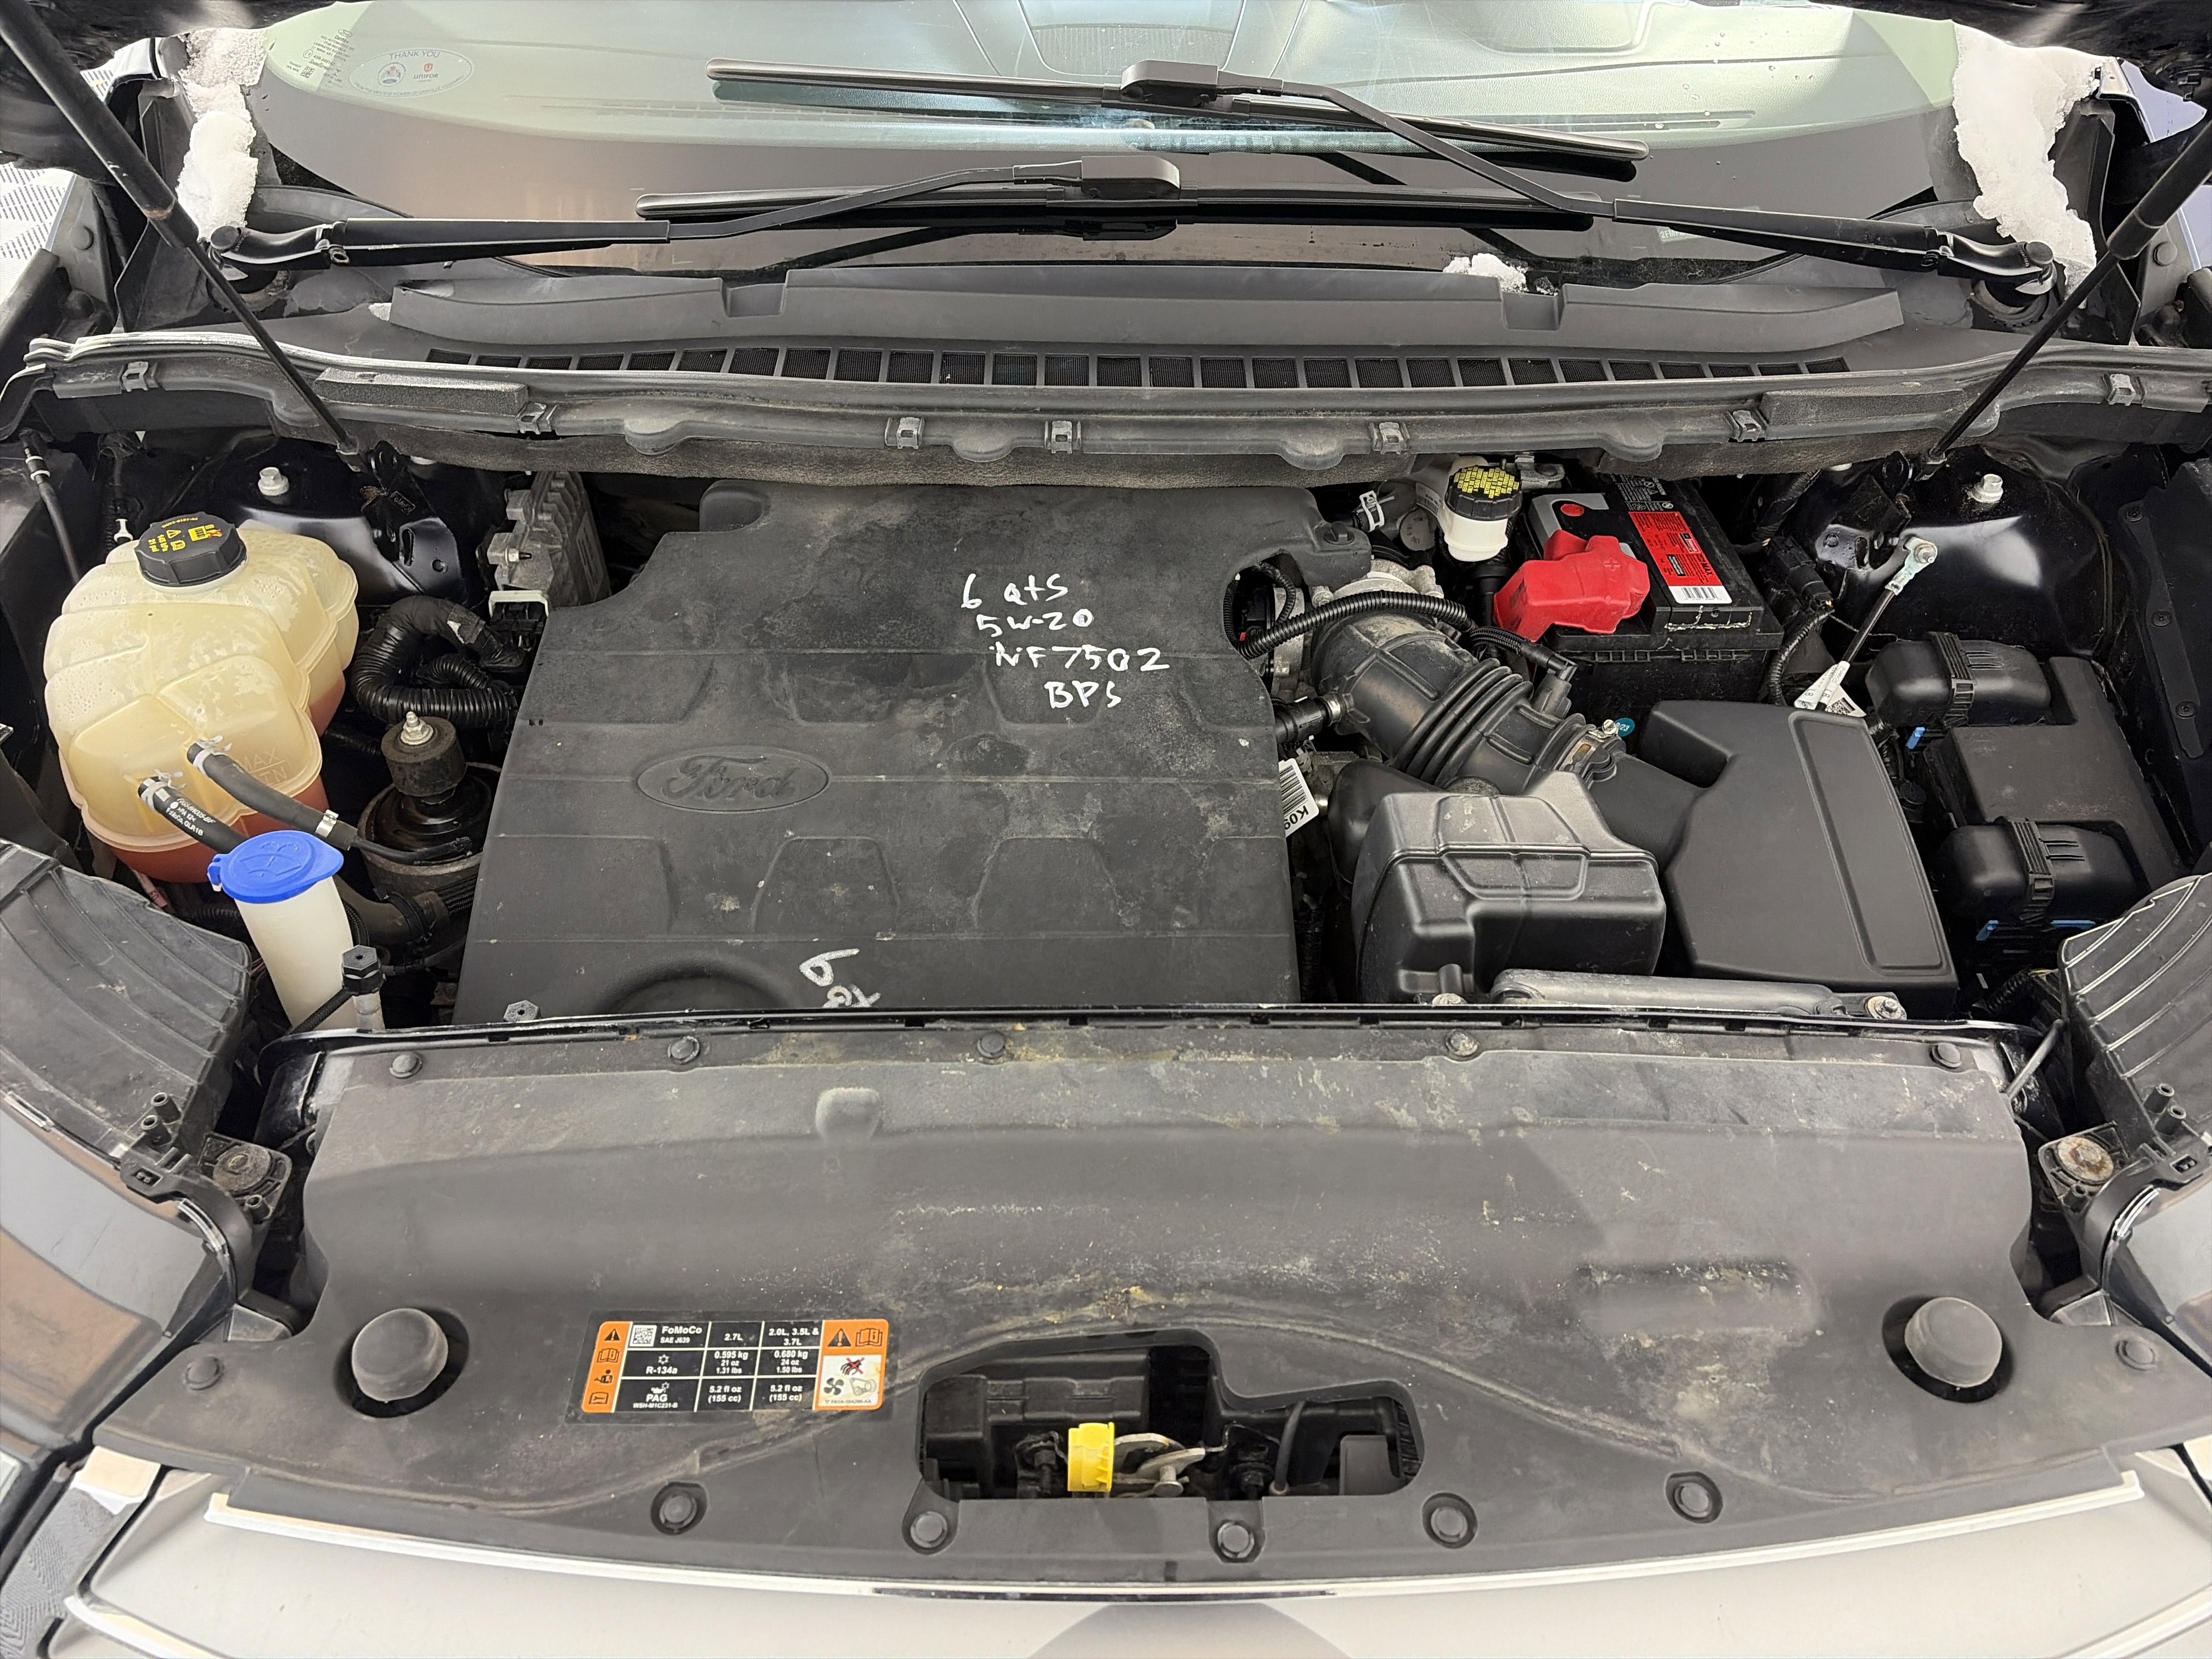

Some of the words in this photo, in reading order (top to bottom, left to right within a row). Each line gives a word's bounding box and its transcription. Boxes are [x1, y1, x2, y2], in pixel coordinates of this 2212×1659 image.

[390, 50, 419, 60] THANK
[961, 573, 983, 608] 6
[661, 755, 798, 799] Ford
[662, 1325, 702, 1334] FoMoCo
[738, 1351, 749, 1360] kg
[798, 1350, 808, 1359] kg
[646, 1366, 678, 1374] R-134a
[646, 1394, 668, 1402] PAG
[708, 1395, 727, 1403] (155
[728, 1395, 741, 1403] cc)
[769, 1394, 788, 1403] (155
[789, 1393, 803, 1402] cc)
